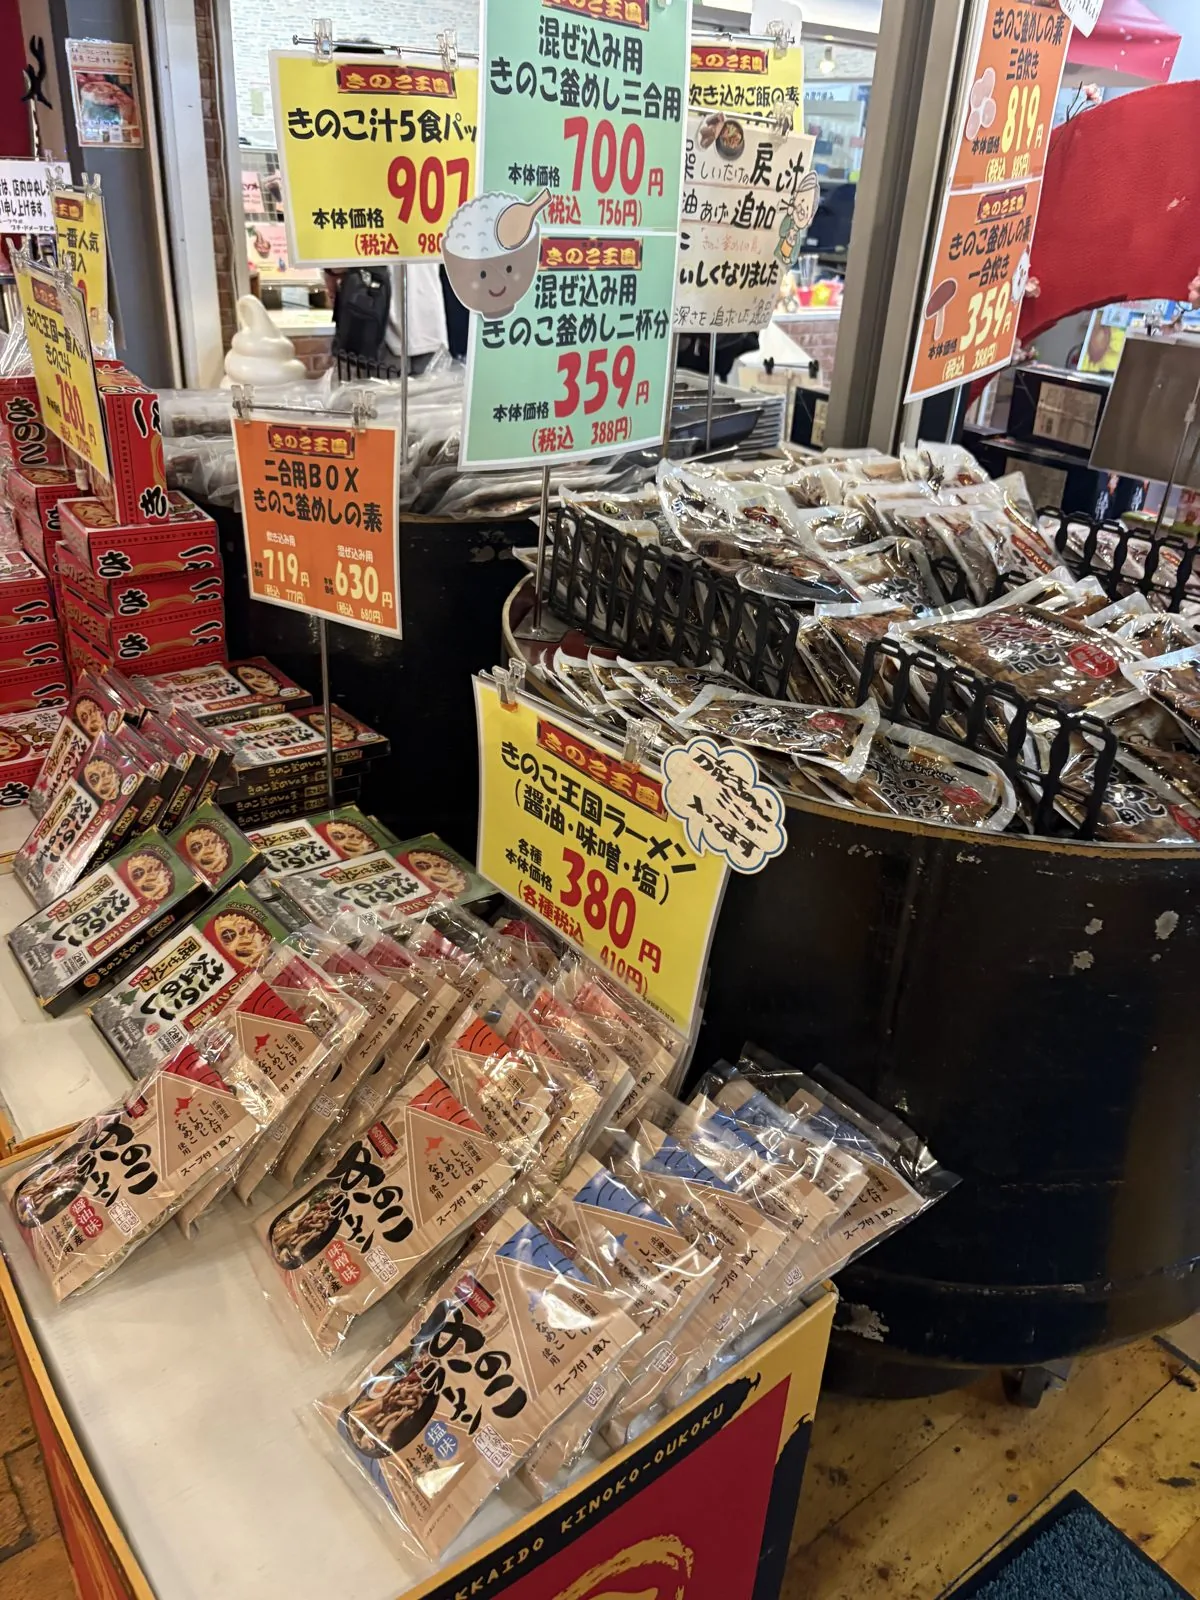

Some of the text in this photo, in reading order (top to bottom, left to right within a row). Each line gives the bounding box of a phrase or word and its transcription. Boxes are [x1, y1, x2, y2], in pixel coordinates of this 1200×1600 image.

[539, 15, 643, 75] 混ぜ込み用
[992, 7, 1065, 46] きのこ釜めしの素
[1006, 48, 1039, 81] 三合炊き
[490, 57, 681, 122] きのこ釜めし三合用
[508, 163, 560, 188] 本体価格
[564, 116, 664, 197] 700円
[1, 179, 51, 197] は、店内中央レ
[312, 156, 469, 229] 本体価格 907
[598, 199, 642, 227] 756円)
[59, 228, 100, 254] 一番人気
[355, 233, 399, 256] (税込
[968, 254, 1010, 287] 一合炊き
[535, 274, 637, 310] 混ぜ込み用
[482, 309, 669, 349] きのこ釜めし二杯分
[960, 281, 1013, 351] 359円
[493, 344, 649, 422] 本体価格 359円
[532, 416, 632, 453] (税込 388円)
[254, 487, 383, 533] きのこ釜めしの素
[263, 549, 310, 588] 719円
[335, 560, 393, 608] 630円
[501, 742, 697, 874] きのこ王国ラーメン
[514, 779, 670, 905] (醤油・味噌・塩)
[518, 838, 543, 864] 各種
[505, 847, 662, 974] 本体価格 380円
[517, 880, 585, 947] (各種税込
[600, 945, 649, 996] 410円)
[177, 1122, 199, 1146] なめこ
[187, 1112, 209, 1138] しめじ
[198, 1106, 223, 1134] しいたけ
[180, 1134, 236, 1177] スープ付 1食入
[439, 1156, 462, 1181] しめじ
[451, 1148, 476, 1178] しいたけ
[427, 1163, 450, 1188] なめこ
[428, 1184, 444, 1201] 使用
[70, 1198, 104, 1237] 醤油味
[435, 1177, 489, 1227] スープ付 1食入
[843, 1215, 874, 1241] スープ付
[326, 1241, 362, 1286] 味噌味
[535, 1320, 565, 1353] なめこ
[541, 1349, 561, 1367] 使用
[553, 1337, 612, 1396] スープ付 1食入
[424, 1421, 460, 1461] 塩味
[446, 1404, 726, 1600] KKAIDO KINOKO-OUKOKU
